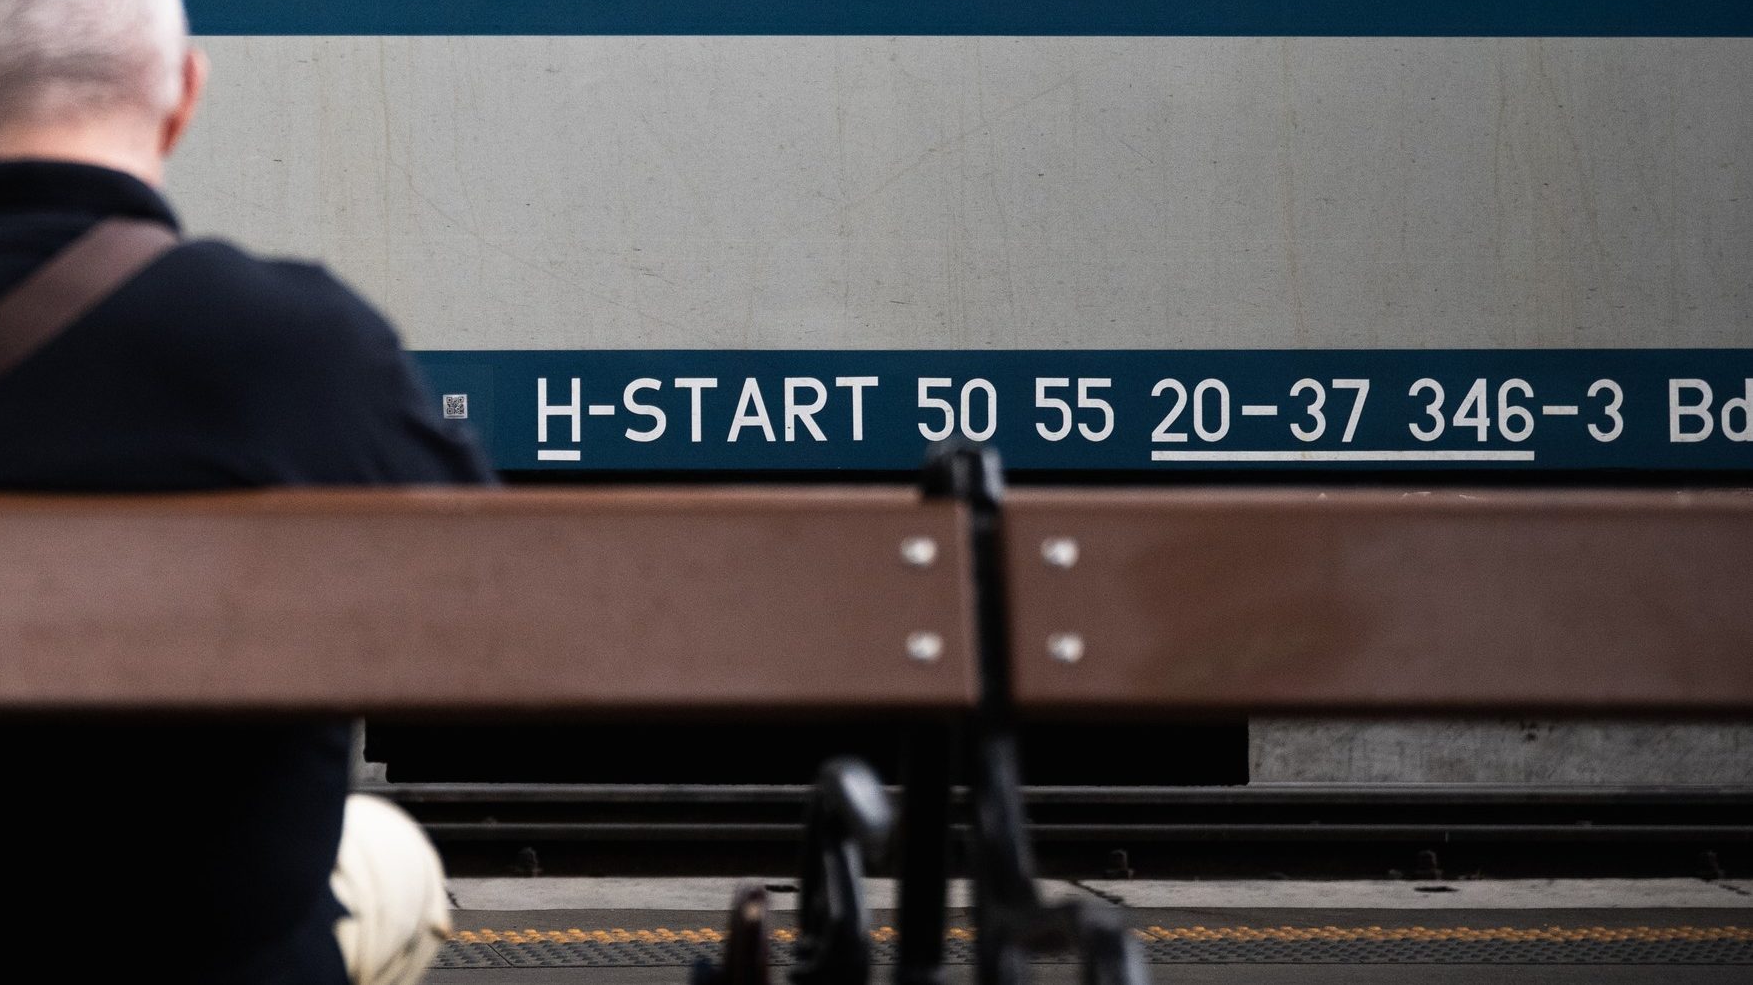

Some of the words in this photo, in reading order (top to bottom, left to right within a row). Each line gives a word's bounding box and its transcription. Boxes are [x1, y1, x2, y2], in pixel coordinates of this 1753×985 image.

[537, 377, 880, 443] H-START
[917, 377, 998, 442] 50
[1035, 377, 1115, 442] 55
[1151, 378, 1370, 443] 20-37
[1408, 378, 1624, 442] 346-3
[1669, 378, 1753, 443] Bd
